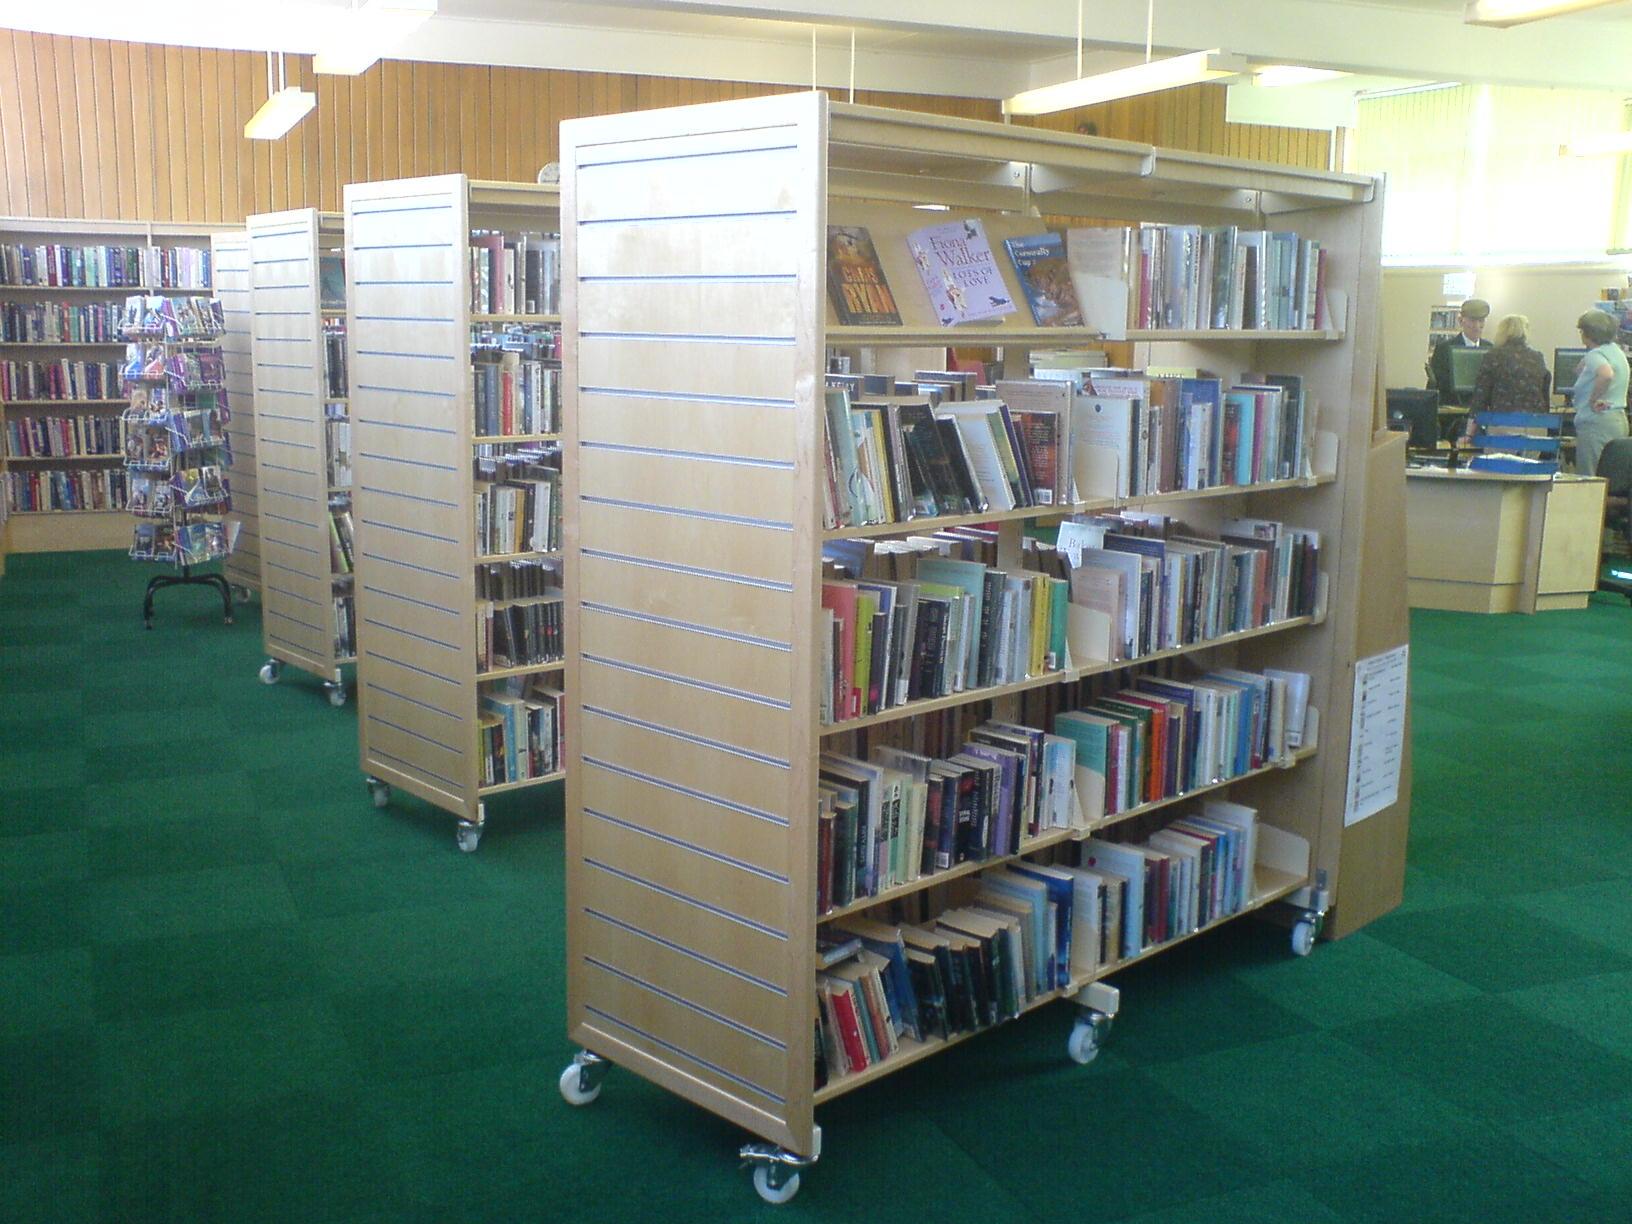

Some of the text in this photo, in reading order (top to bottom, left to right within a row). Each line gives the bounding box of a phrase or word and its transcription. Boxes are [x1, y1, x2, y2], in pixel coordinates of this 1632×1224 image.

[930, 236, 967, 250] Fiona
[935, 246, 990, 266] Walker
[962, 277, 990, 288] LOVE
